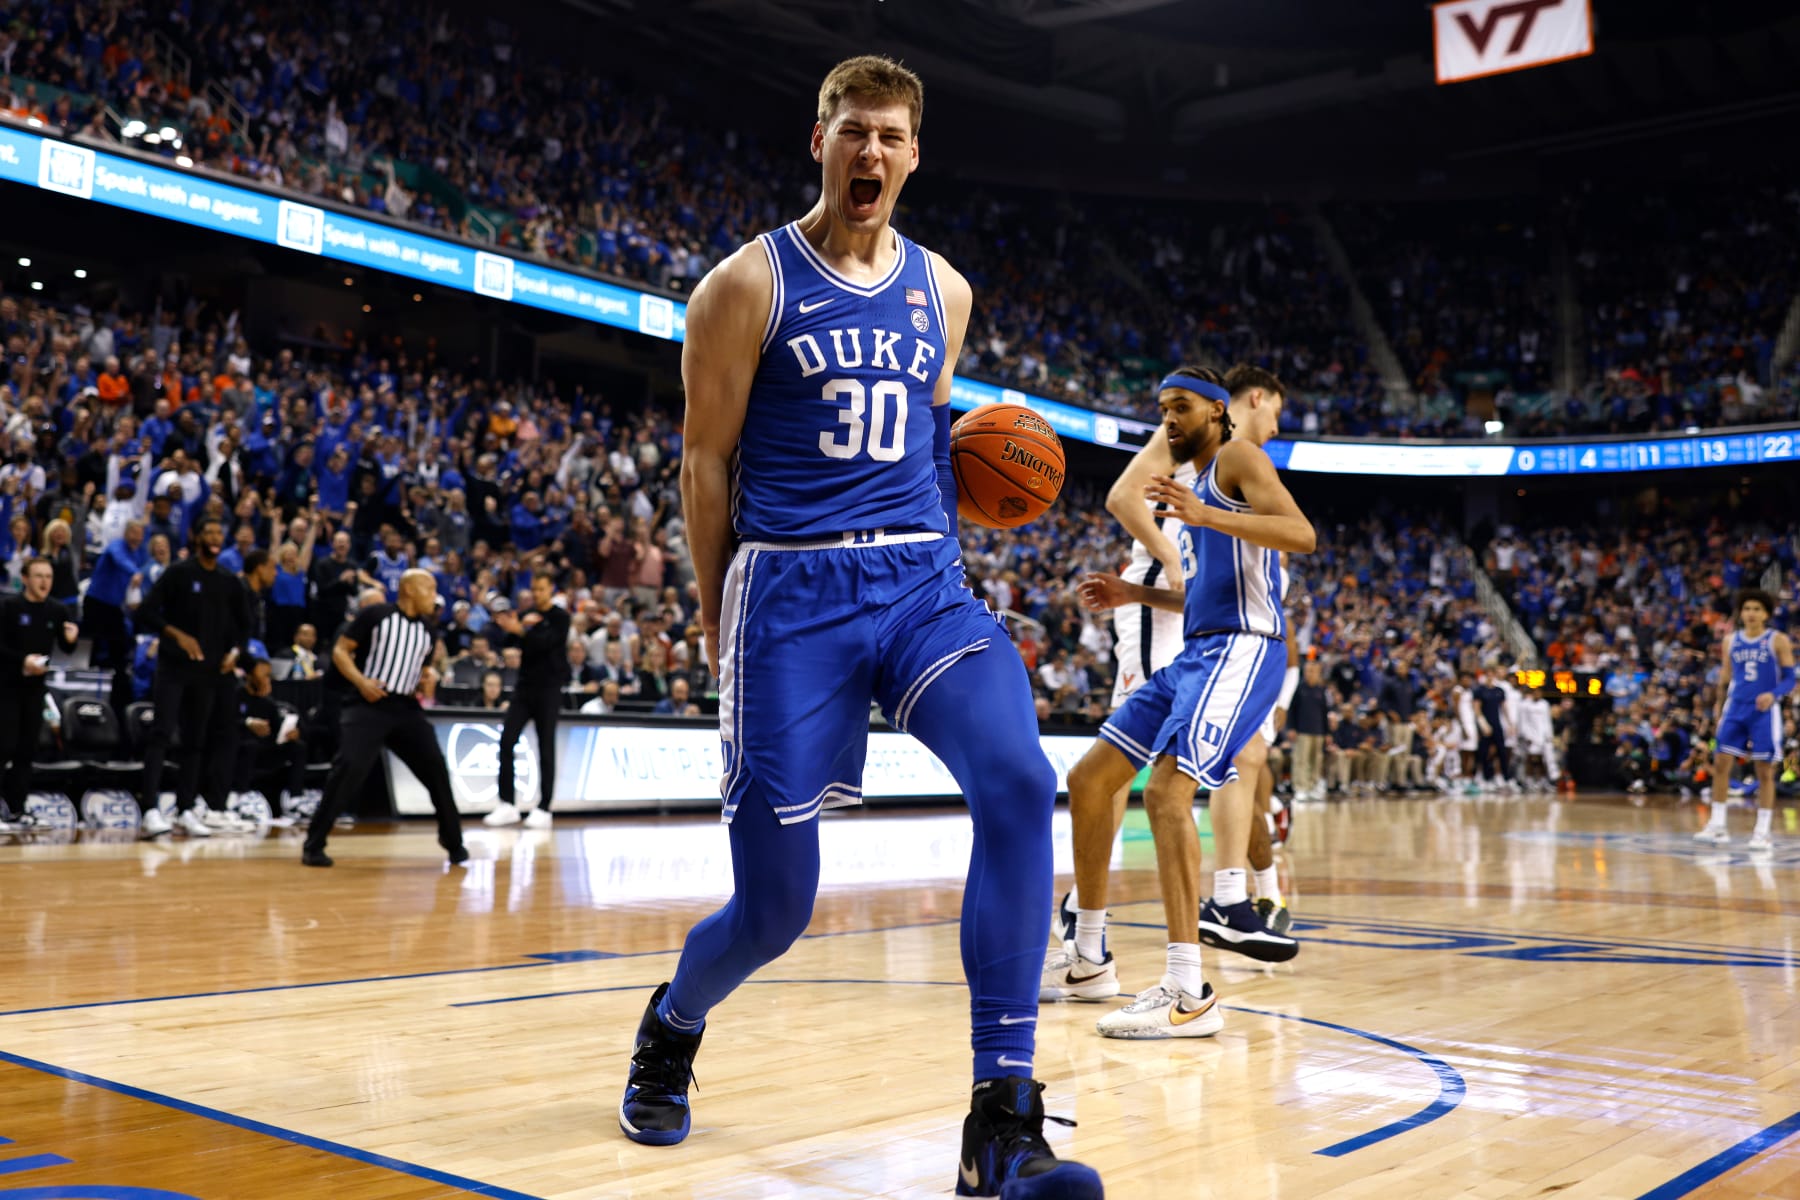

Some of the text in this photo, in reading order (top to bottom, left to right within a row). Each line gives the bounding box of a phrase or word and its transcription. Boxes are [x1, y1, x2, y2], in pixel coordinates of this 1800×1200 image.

[1454, 0, 1563, 57] VT
[95, 165, 148, 196] Speak
[149, 183, 187, 205] with
[188, 193, 211, 210] an
[212, 199, 261, 224] agent.
[324, 222, 367, 251] Speak
[368, 236, 400, 258] with
[401, 245, 420, 263] an
[514, 271, 549, 296] Speak
[551, 283, 578, 303] with
[579, 291, 594, 306] an
[788, 328, 935, 383] DUKE
[818, 378, 908, 462] 30
[1518, 450, 1536, 471] 0
[1580, 449, 1597, 468] 4
[1638, 445, 1661, 466] 11
[1702, 441, 1728, 463] 13
[1764, 436, 1793, 458] 22
[1732, 649, 1769, 663] DUKE
[1744, 661, 1758, 682] 5
[1201, 720, 1223, 747] D
[611, 747, 721, 780] MULTIPLE
